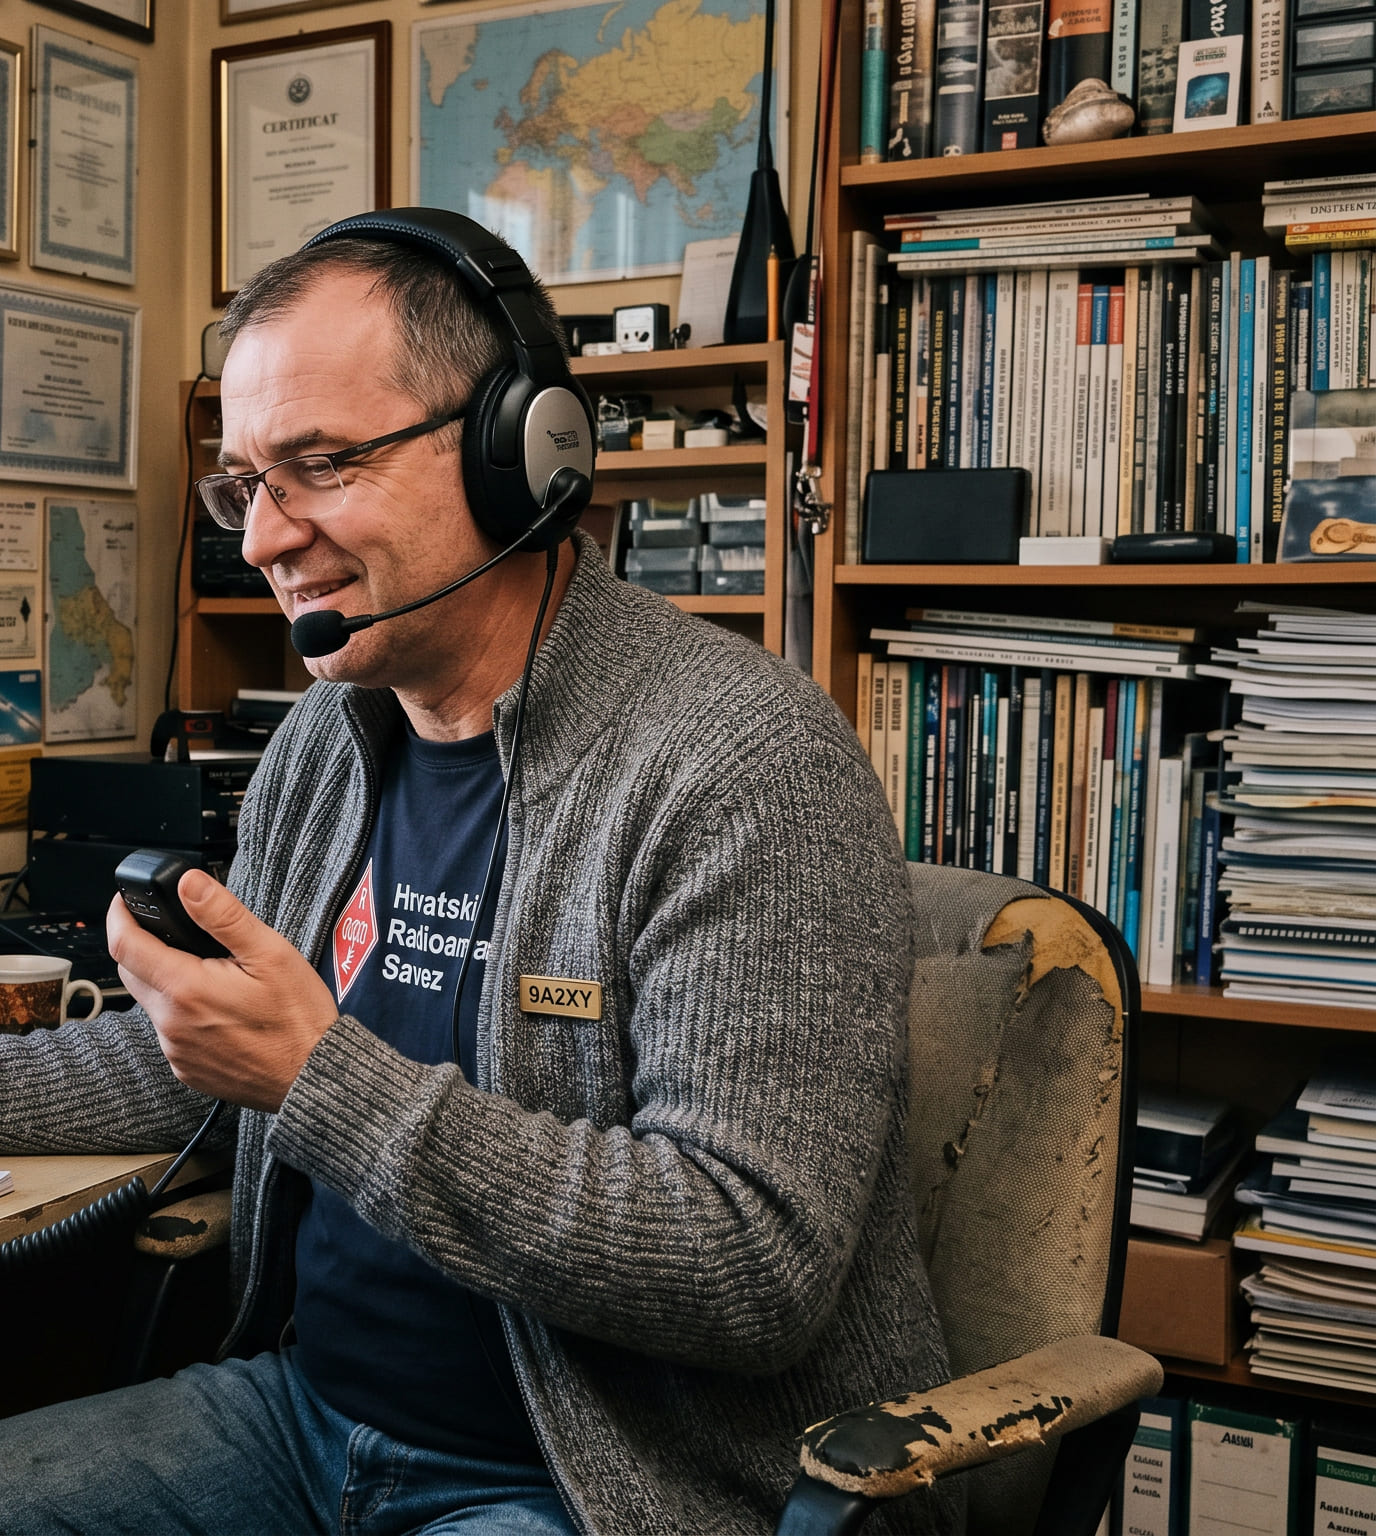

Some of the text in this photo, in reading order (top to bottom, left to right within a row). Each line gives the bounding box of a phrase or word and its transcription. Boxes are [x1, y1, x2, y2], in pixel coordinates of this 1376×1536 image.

[262, 113, 339, 135] CERTIFICAT
[393, 884, 479, 922] Hrvatski
[382, 954, 444, 992] Savez
[528, 986, 593, 1009] 9A2XY
